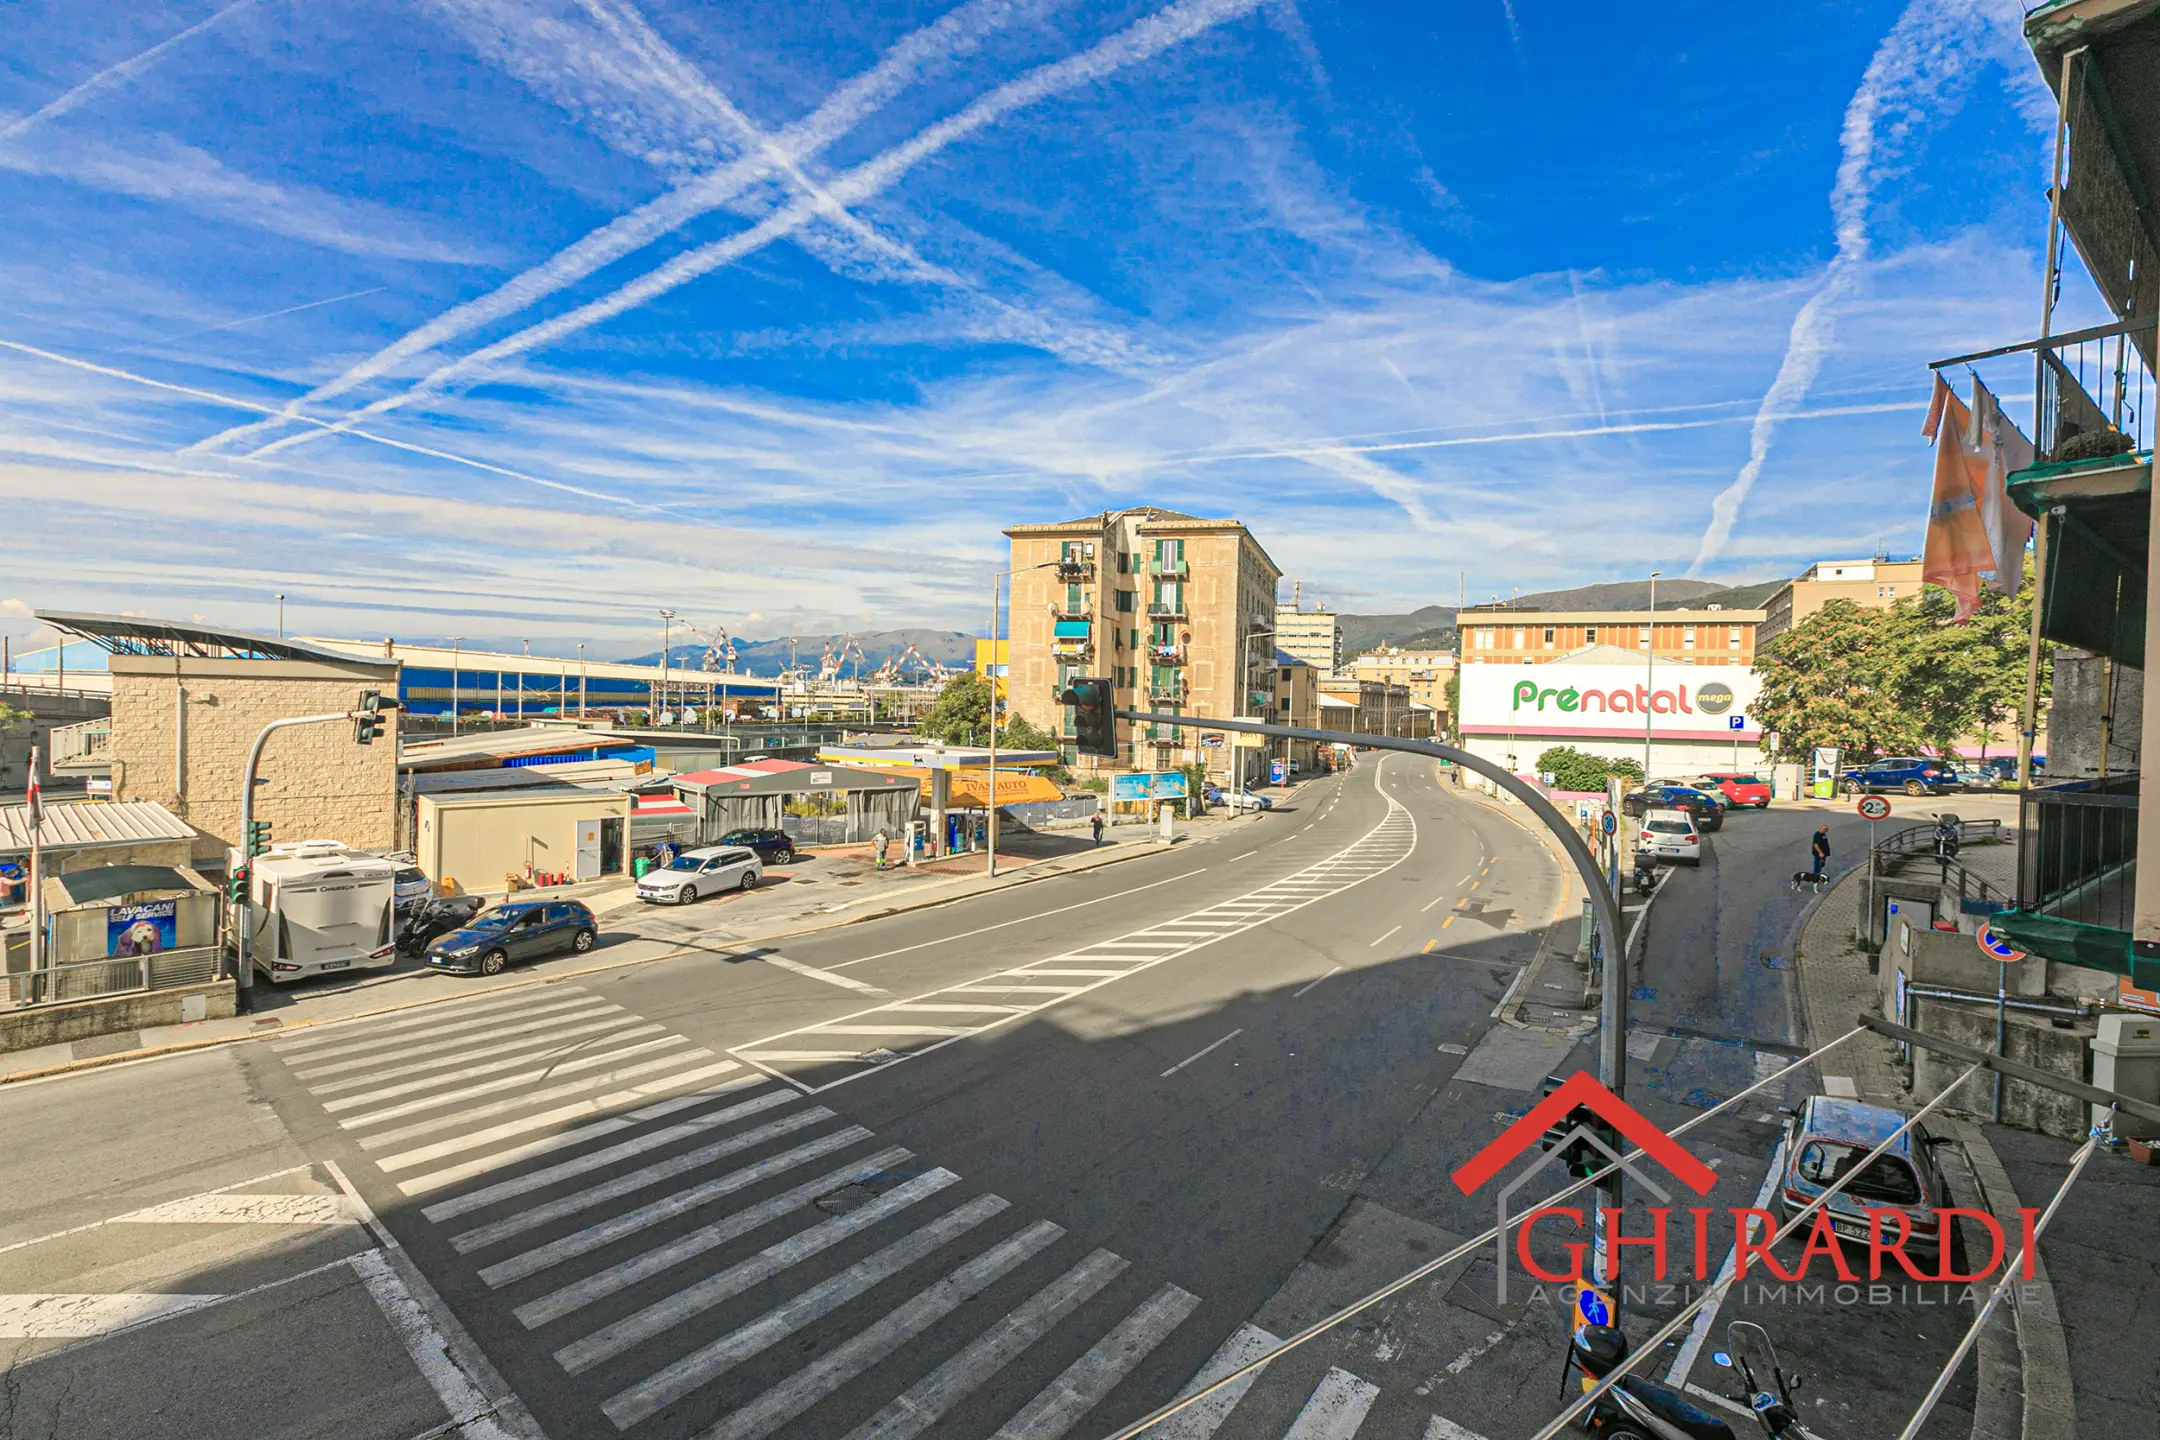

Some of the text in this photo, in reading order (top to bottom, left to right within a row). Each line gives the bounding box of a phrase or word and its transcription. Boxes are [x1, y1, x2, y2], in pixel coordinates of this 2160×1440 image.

[1513, 680, 1693, 714] Prénatal
[1698, 694, 1732, 704] mega
[1732, 717, 1742, 728] P
[997, 780, 1027, 790] AUTO
[110, 908, 174, 923] SELF SERVICE
